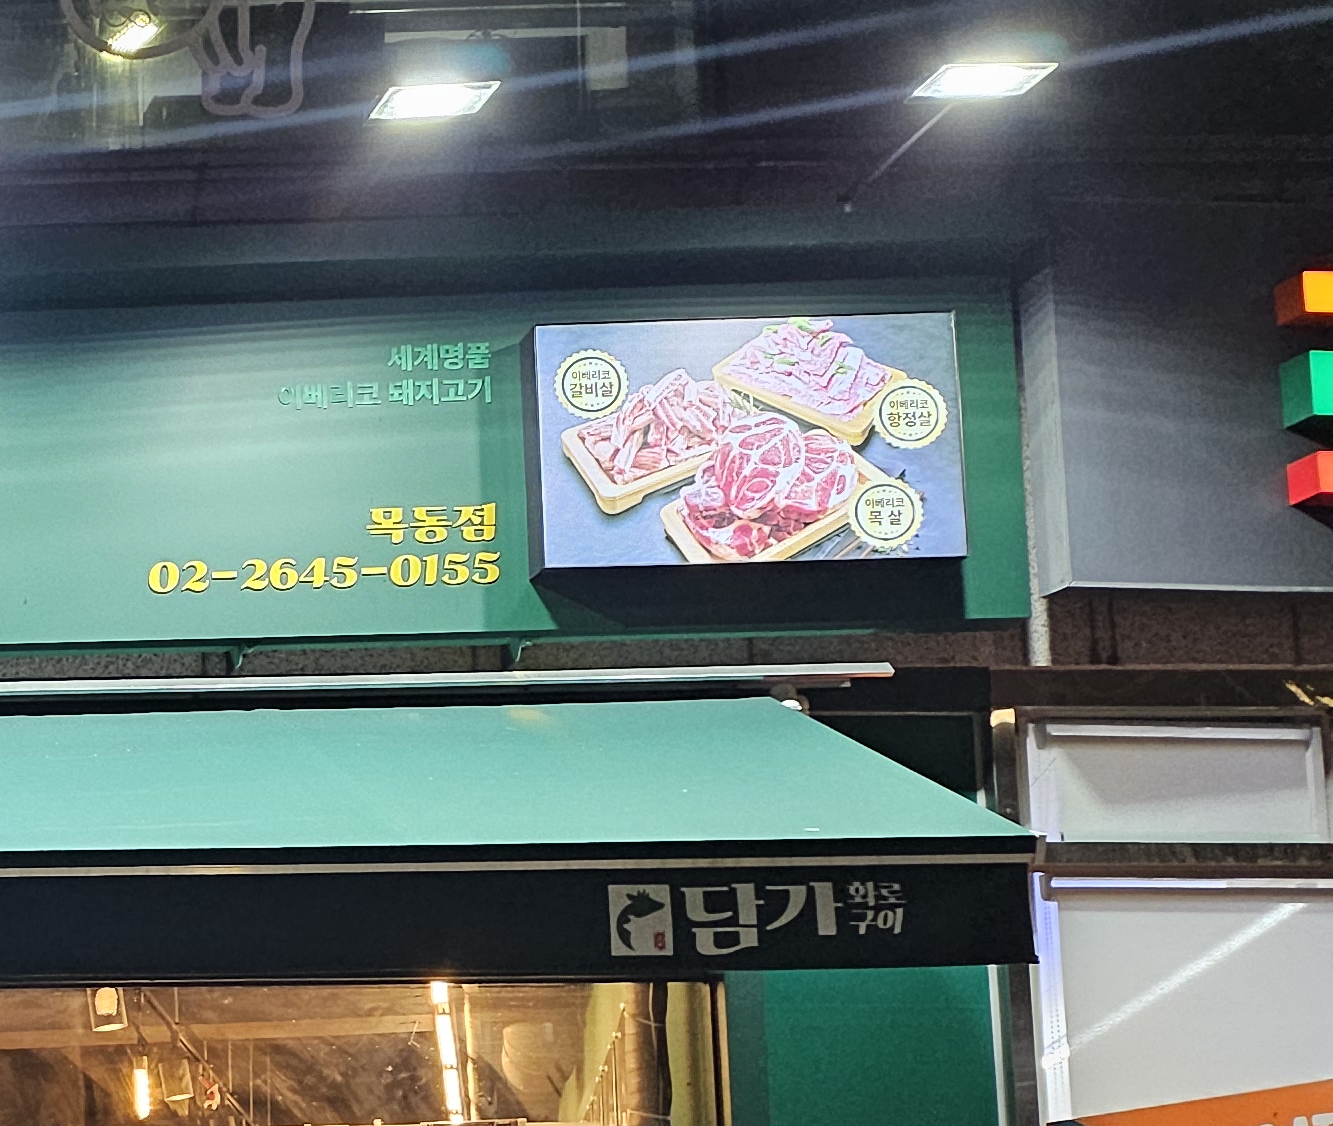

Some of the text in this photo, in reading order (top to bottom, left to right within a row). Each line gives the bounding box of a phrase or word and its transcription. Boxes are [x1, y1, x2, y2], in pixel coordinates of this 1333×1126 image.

[387, 342, 492, 371] 세계명품
[571, 369, 612, 382] 이베리코
[277, 375, 493, 409] 이베리코 돼지고기
[569, 382, 615, 399] 갈비살
[888, 399, 929, 411] 이베리코
[886, 411, 933, 428] 항정살
[864, 498, 905, 510] 이베리코
[365, 503, 498, 545] 목동점
[147, 551, 501, 595] 02-2645-0155
[847, 881, 908, 907] 화로
[680, 881, 844, 956] 담가
[848, 907, 904, 935] 구이
